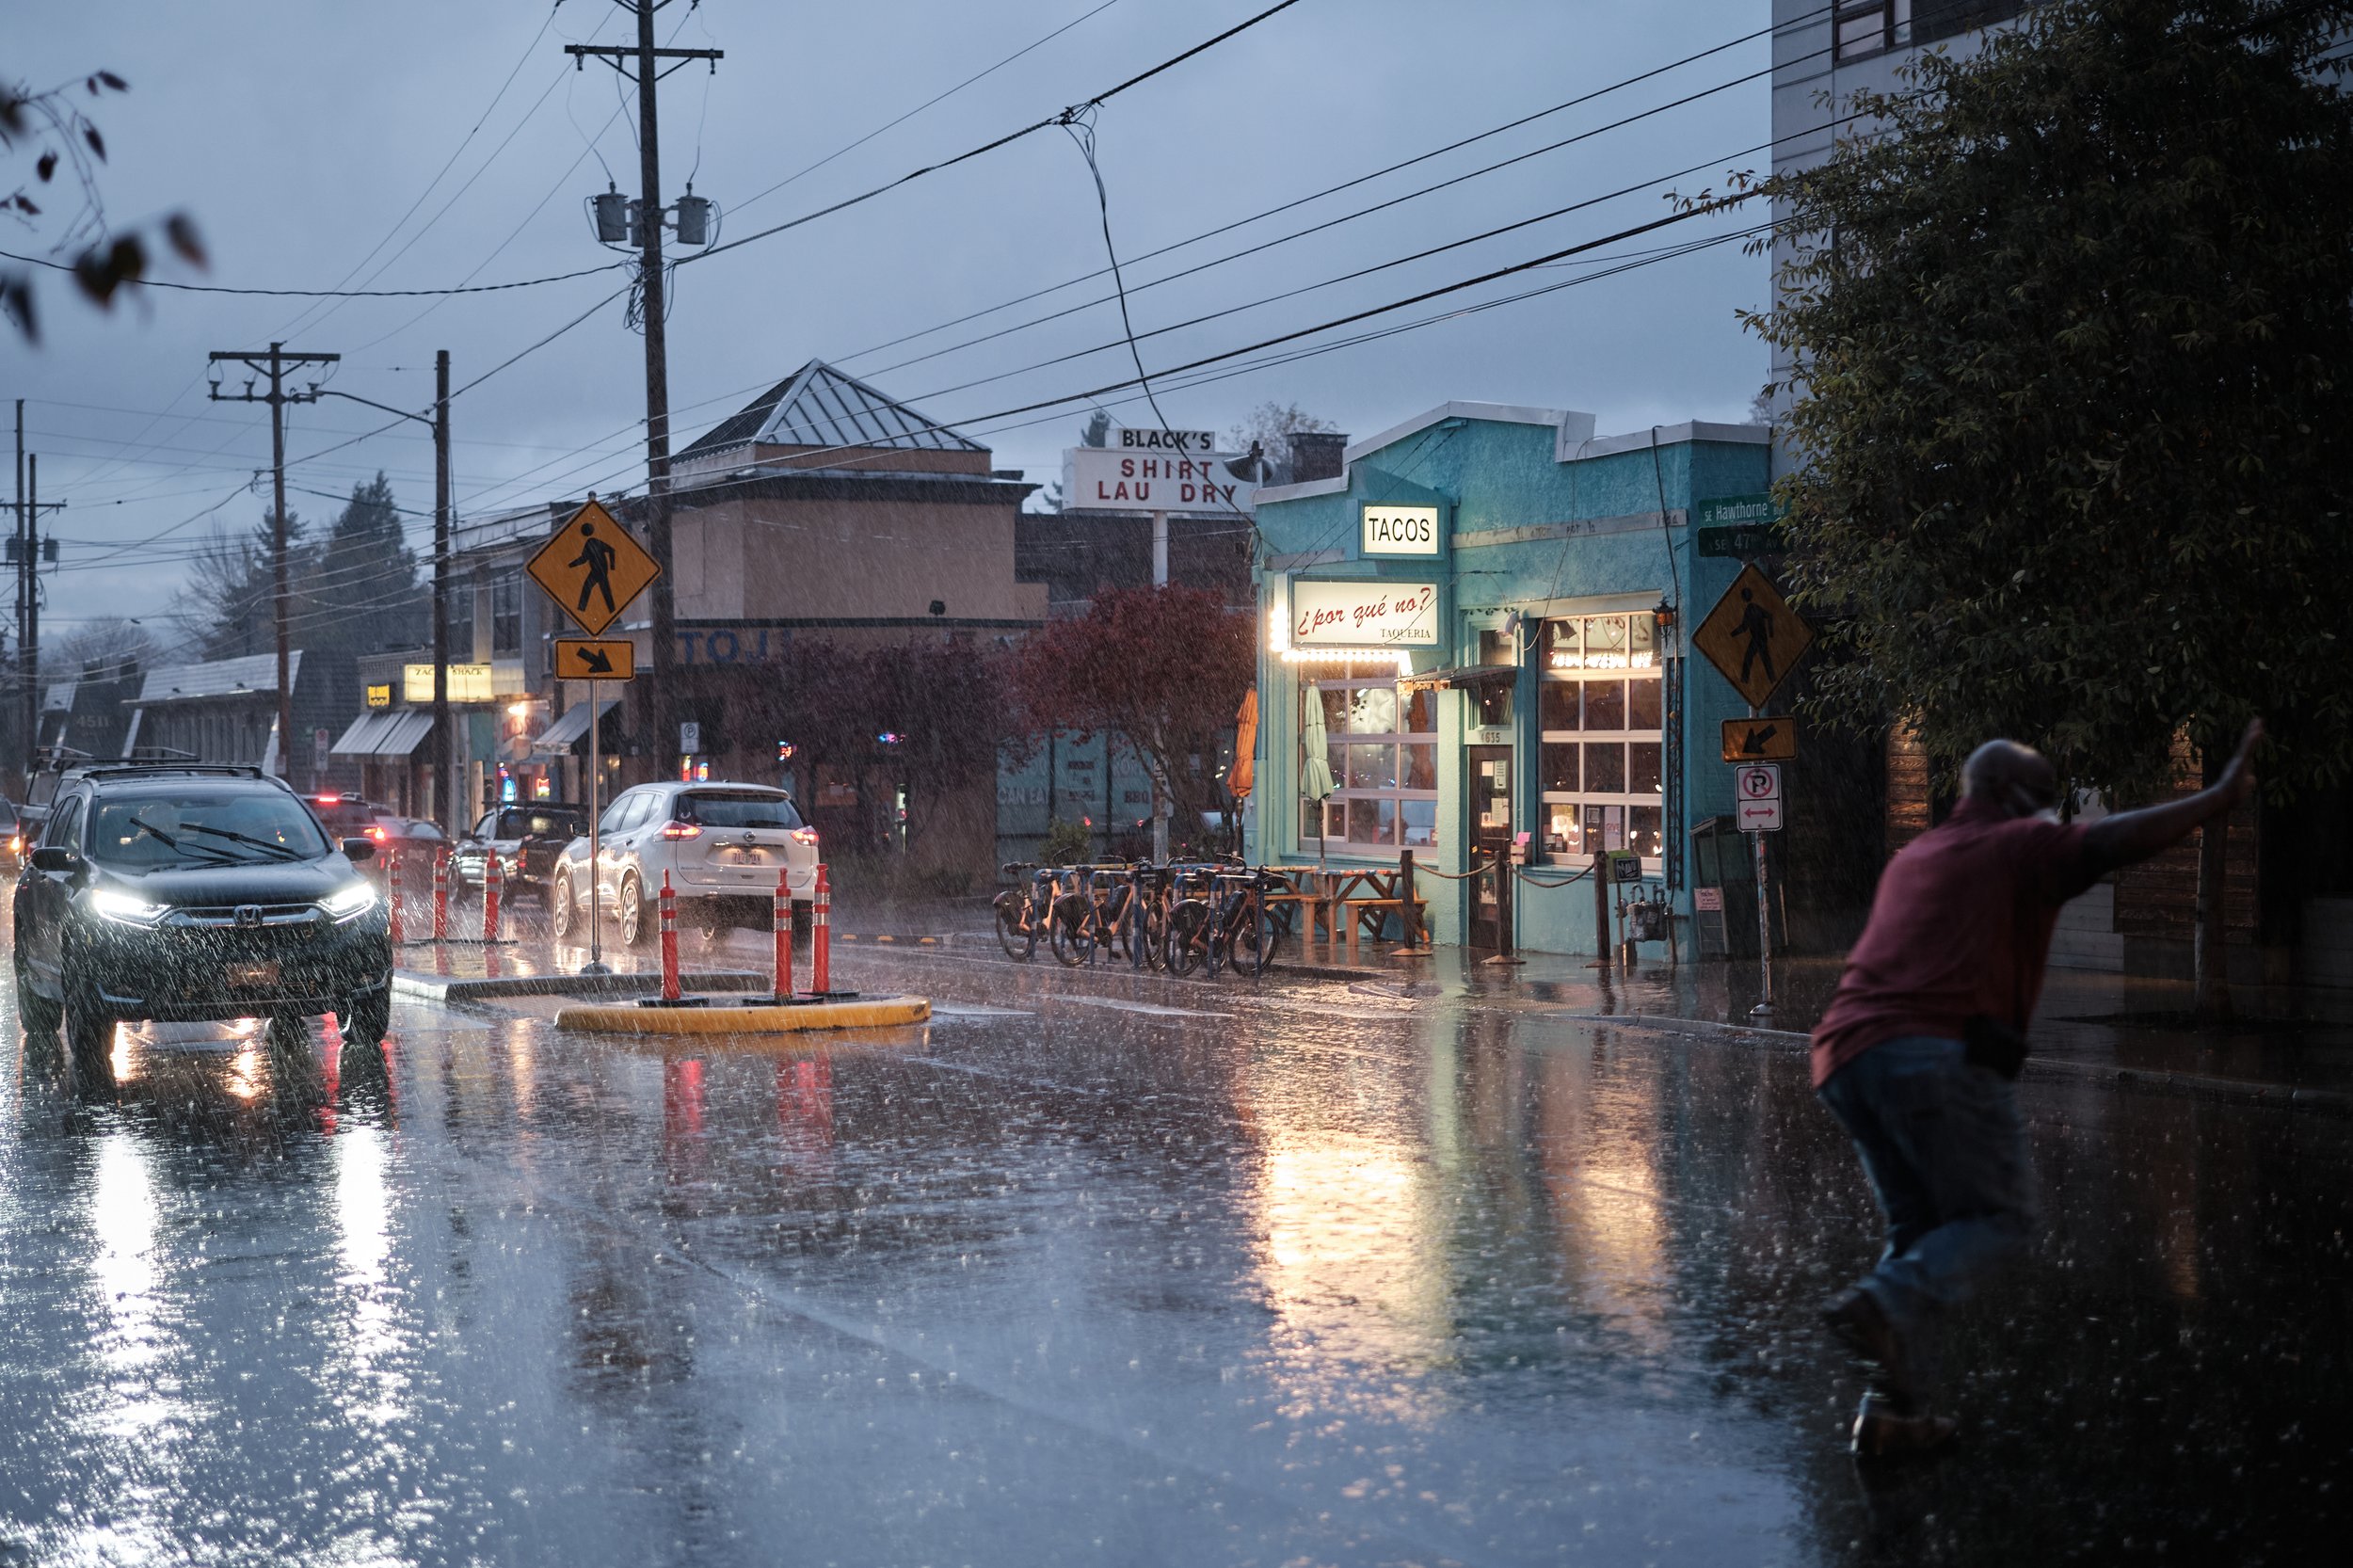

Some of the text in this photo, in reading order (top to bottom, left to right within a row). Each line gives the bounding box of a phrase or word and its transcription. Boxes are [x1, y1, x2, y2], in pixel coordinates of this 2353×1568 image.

[1123, 429, 1211, 450] BLACK'S
[1121, 458, 1212, 480] SHIRT
[1705, 510, 1713, 522] SE
[1716, 502, 1768, 520] Hawthorne
[1369, 518, 1430, 542] TACOS
[1715, 538, 1727, 551] SE
[1297, 587, 1432, 635] ¿por qué no?
[1380, 628, 1431, 640] TAQUERIA
[452, 667, 483, 676] SHACK
[76, 714, 110, 728] 4511
[1125, 791, 1149, 804] BBQ
